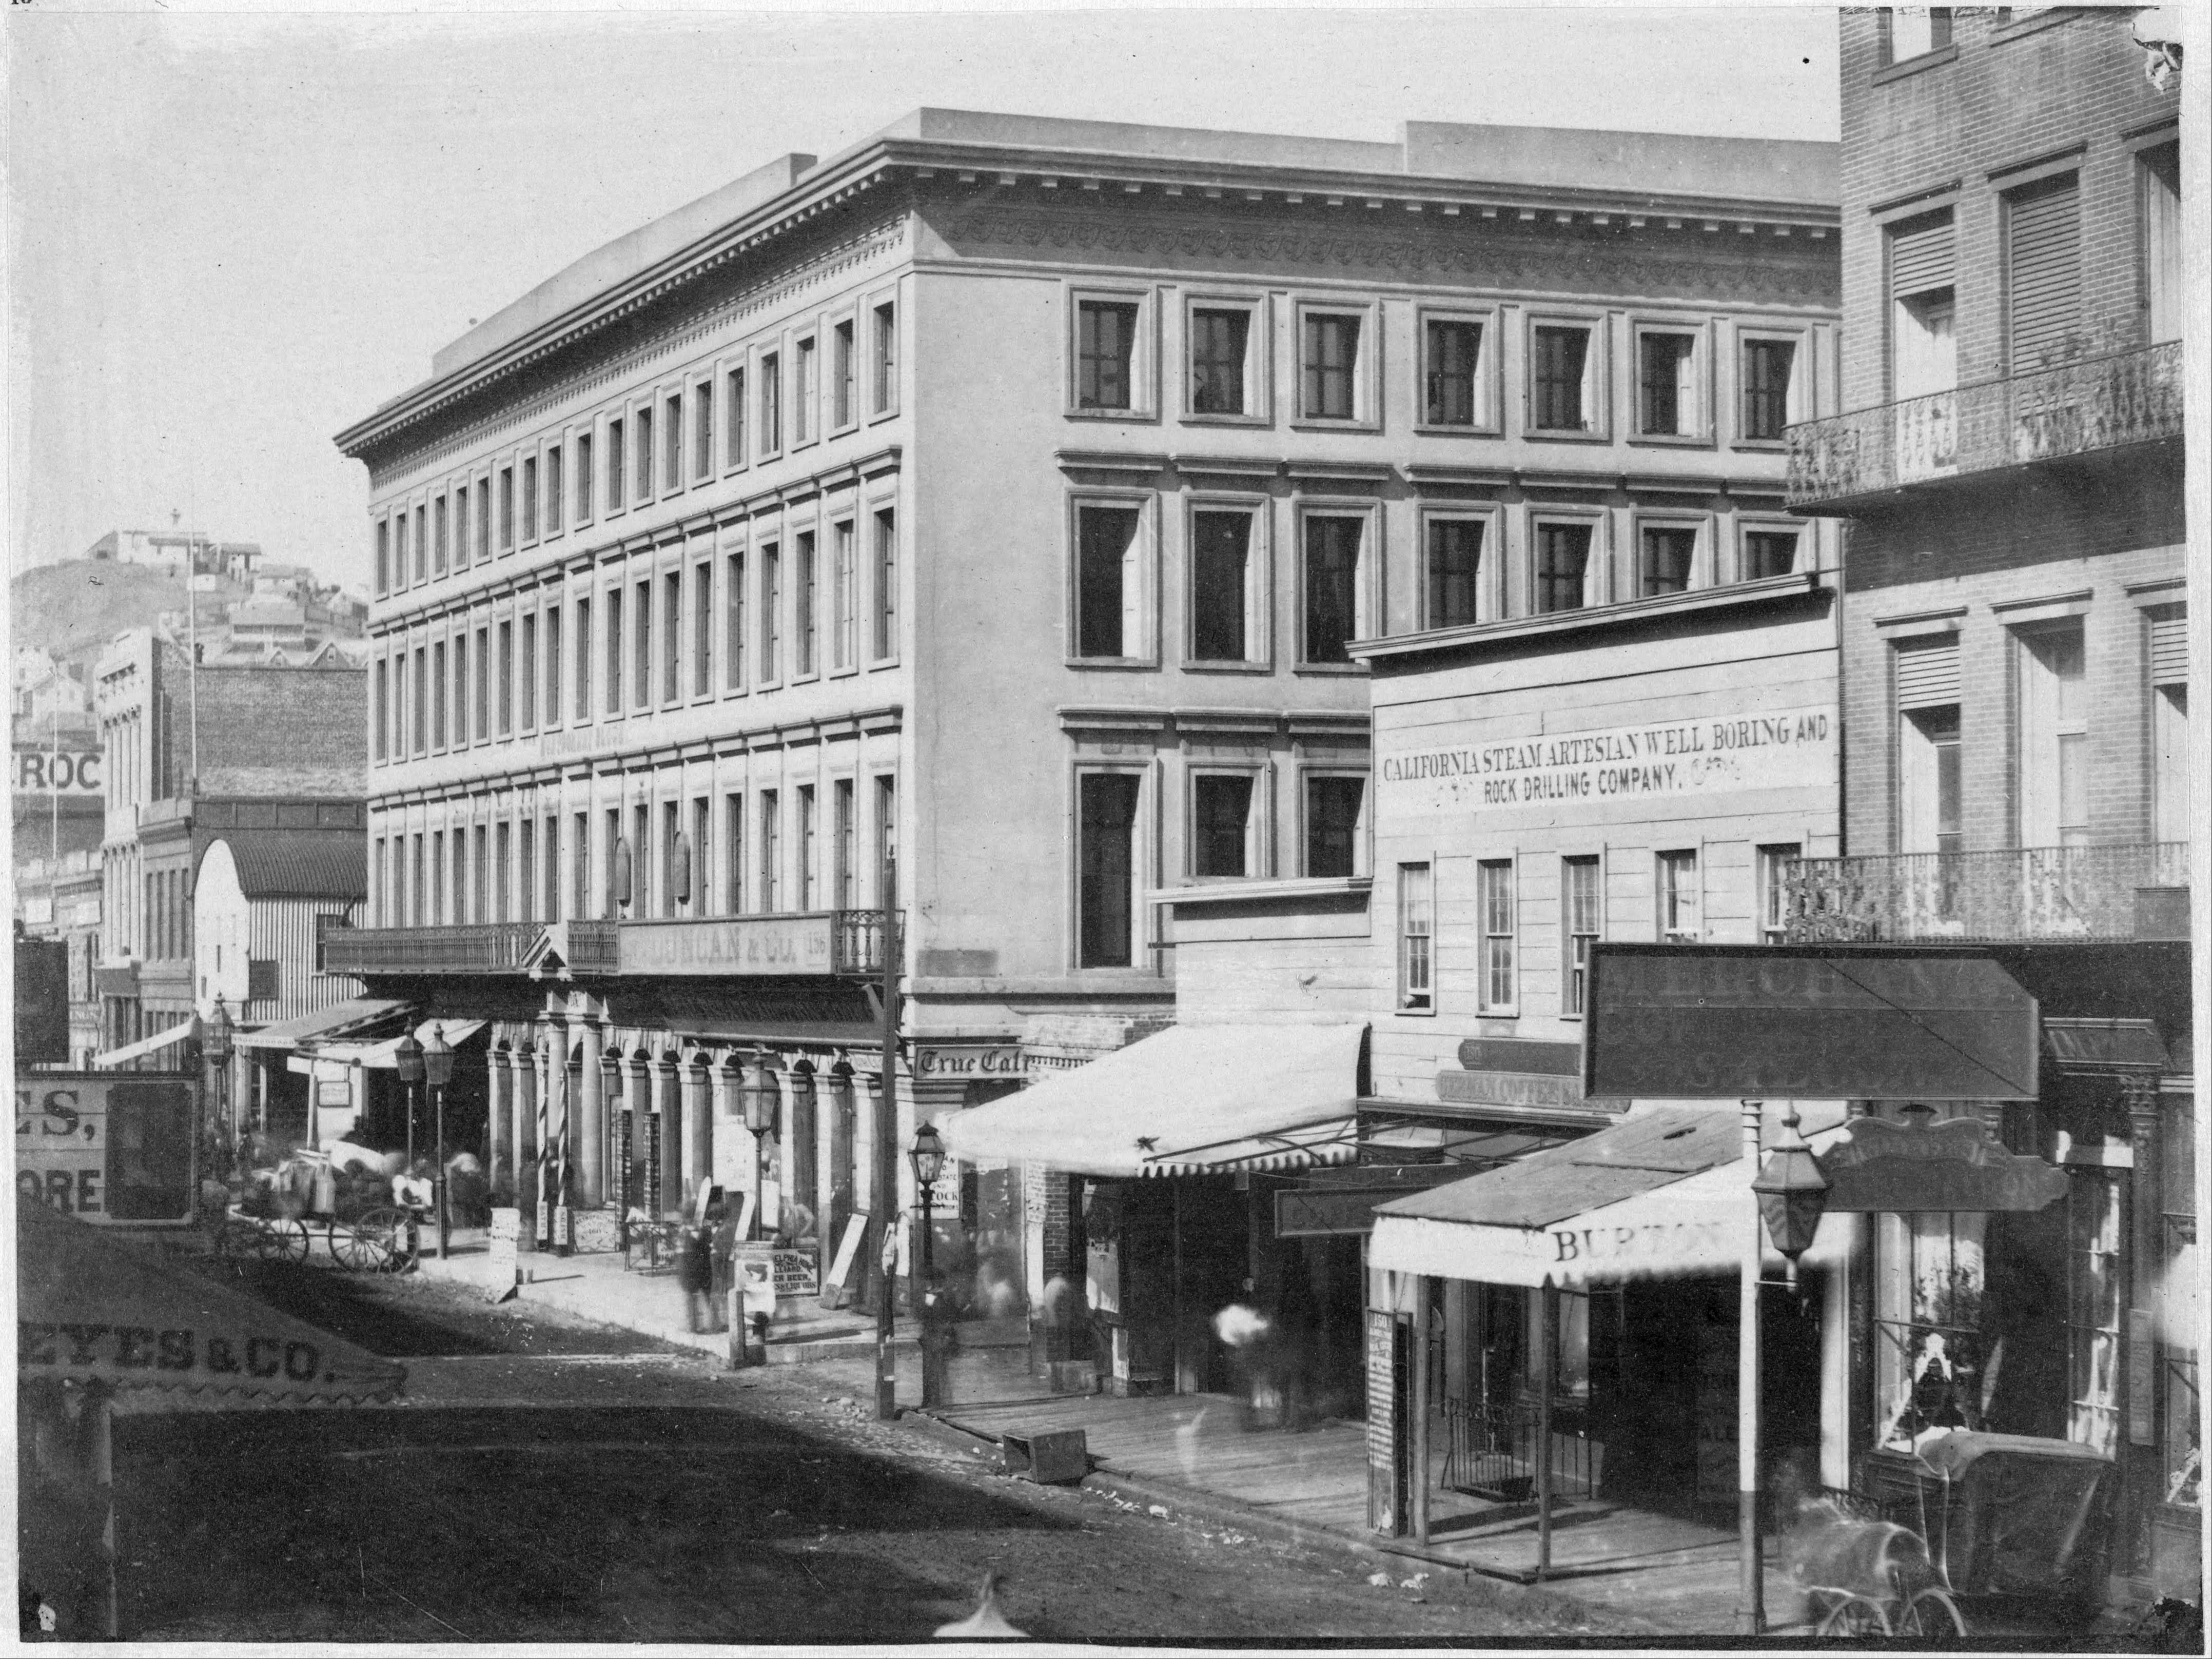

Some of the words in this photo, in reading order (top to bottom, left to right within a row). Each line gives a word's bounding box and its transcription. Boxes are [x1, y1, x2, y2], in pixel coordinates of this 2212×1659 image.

[1383, 750, 1479, 781] CALIFORNIA
[1483, 744, 1544, 774] STEAM
[1545, 733, 1639, 766] ARTESIAN
[1645, 726, 1704, 755] WELL
[1712, 717, 1791, 750] BORING
[1796, 714, 1827, 743] AND
[1484, 779, 1517, 804] ROCK
[1524, 771, 1590, 800] DRILLING
[1598, 763, 1683, 795] COMPANY.
[921, 1050, 976, 1073] True
